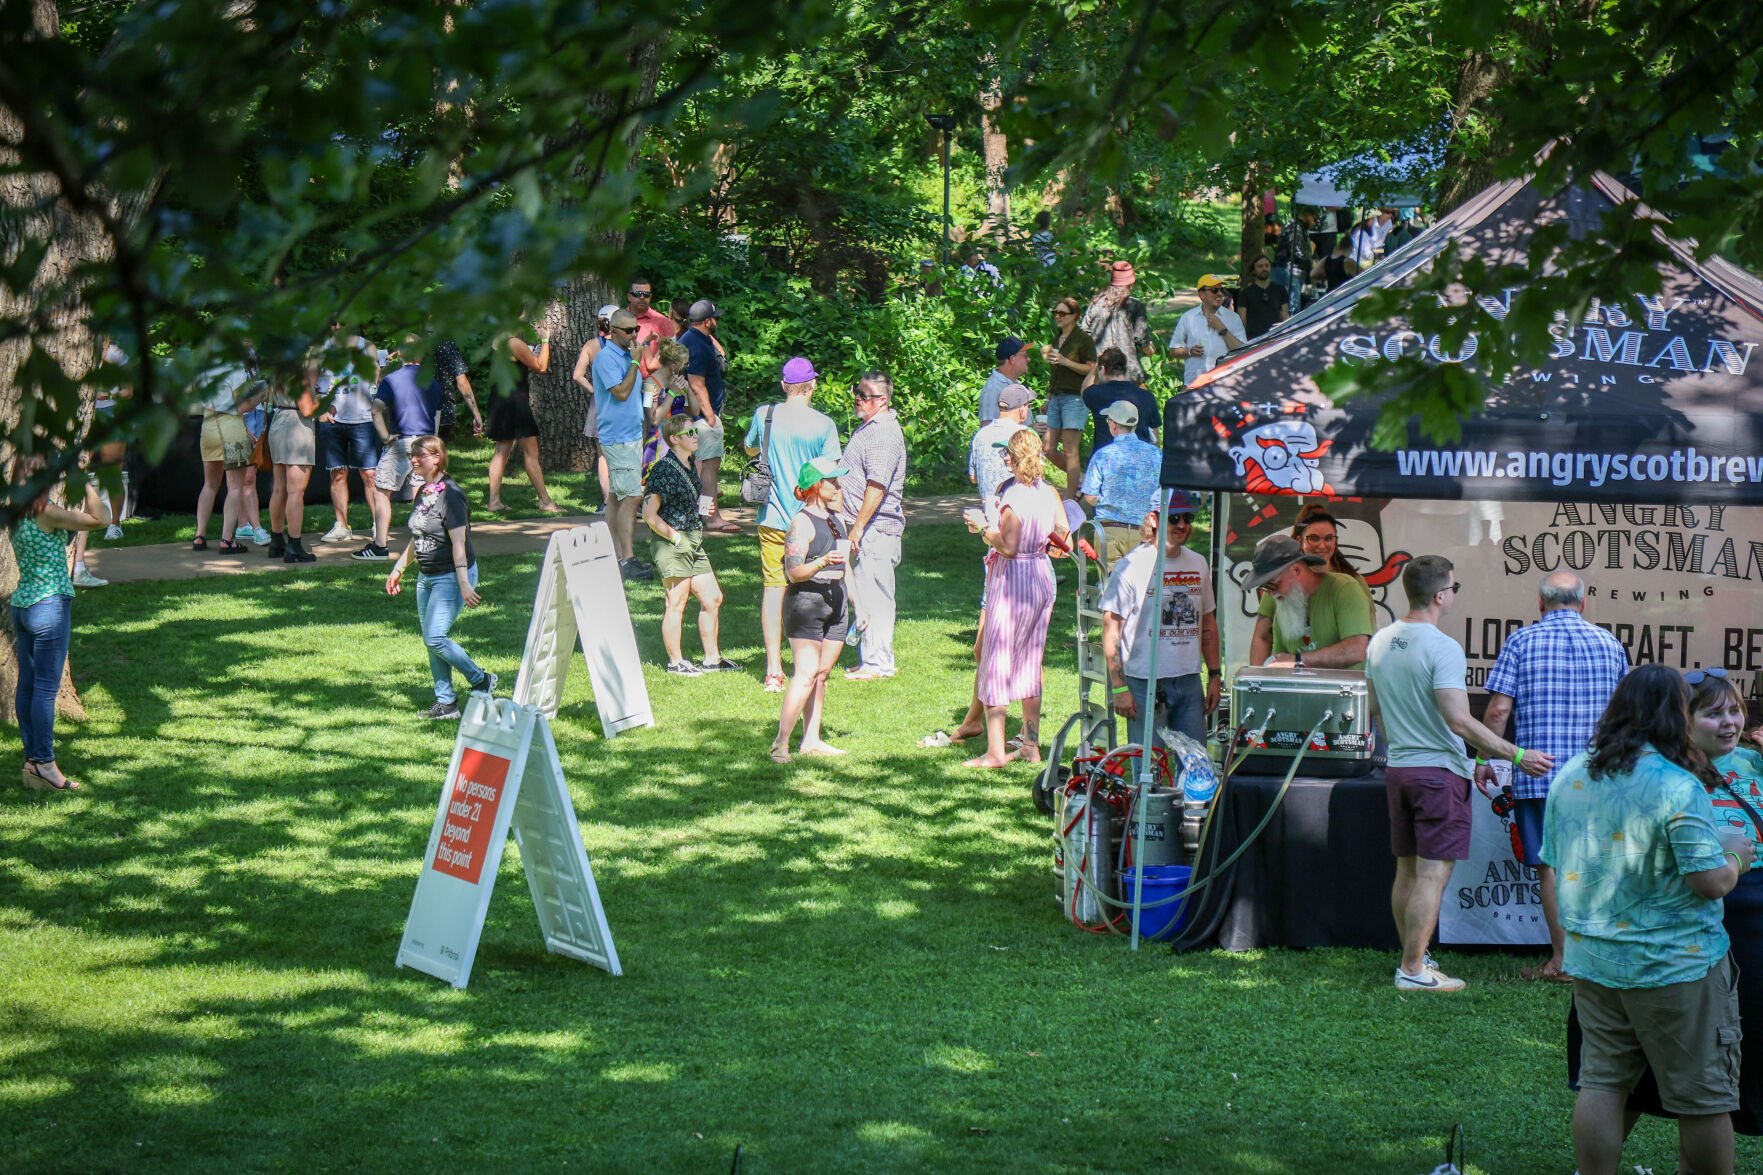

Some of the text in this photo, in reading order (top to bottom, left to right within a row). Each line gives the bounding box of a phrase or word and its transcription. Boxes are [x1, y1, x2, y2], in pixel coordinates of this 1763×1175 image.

[1339, 330, 1760, 376] SCOSMAN
[1587, 585, 1714, 602] REWING
[1595, 622, 1700, 668] RAFT.
[456, 773, 496, 801] No persons
[450, 800, 481, 822] under 21
[444, 818, 472, 843] beyond
[438, 842, 472, 869] this point
[1484, 860, 1540, 884] ANG
[1458, 883, 1542, 910] SCOTS
[1493, 911, 1539, 923] BREW
